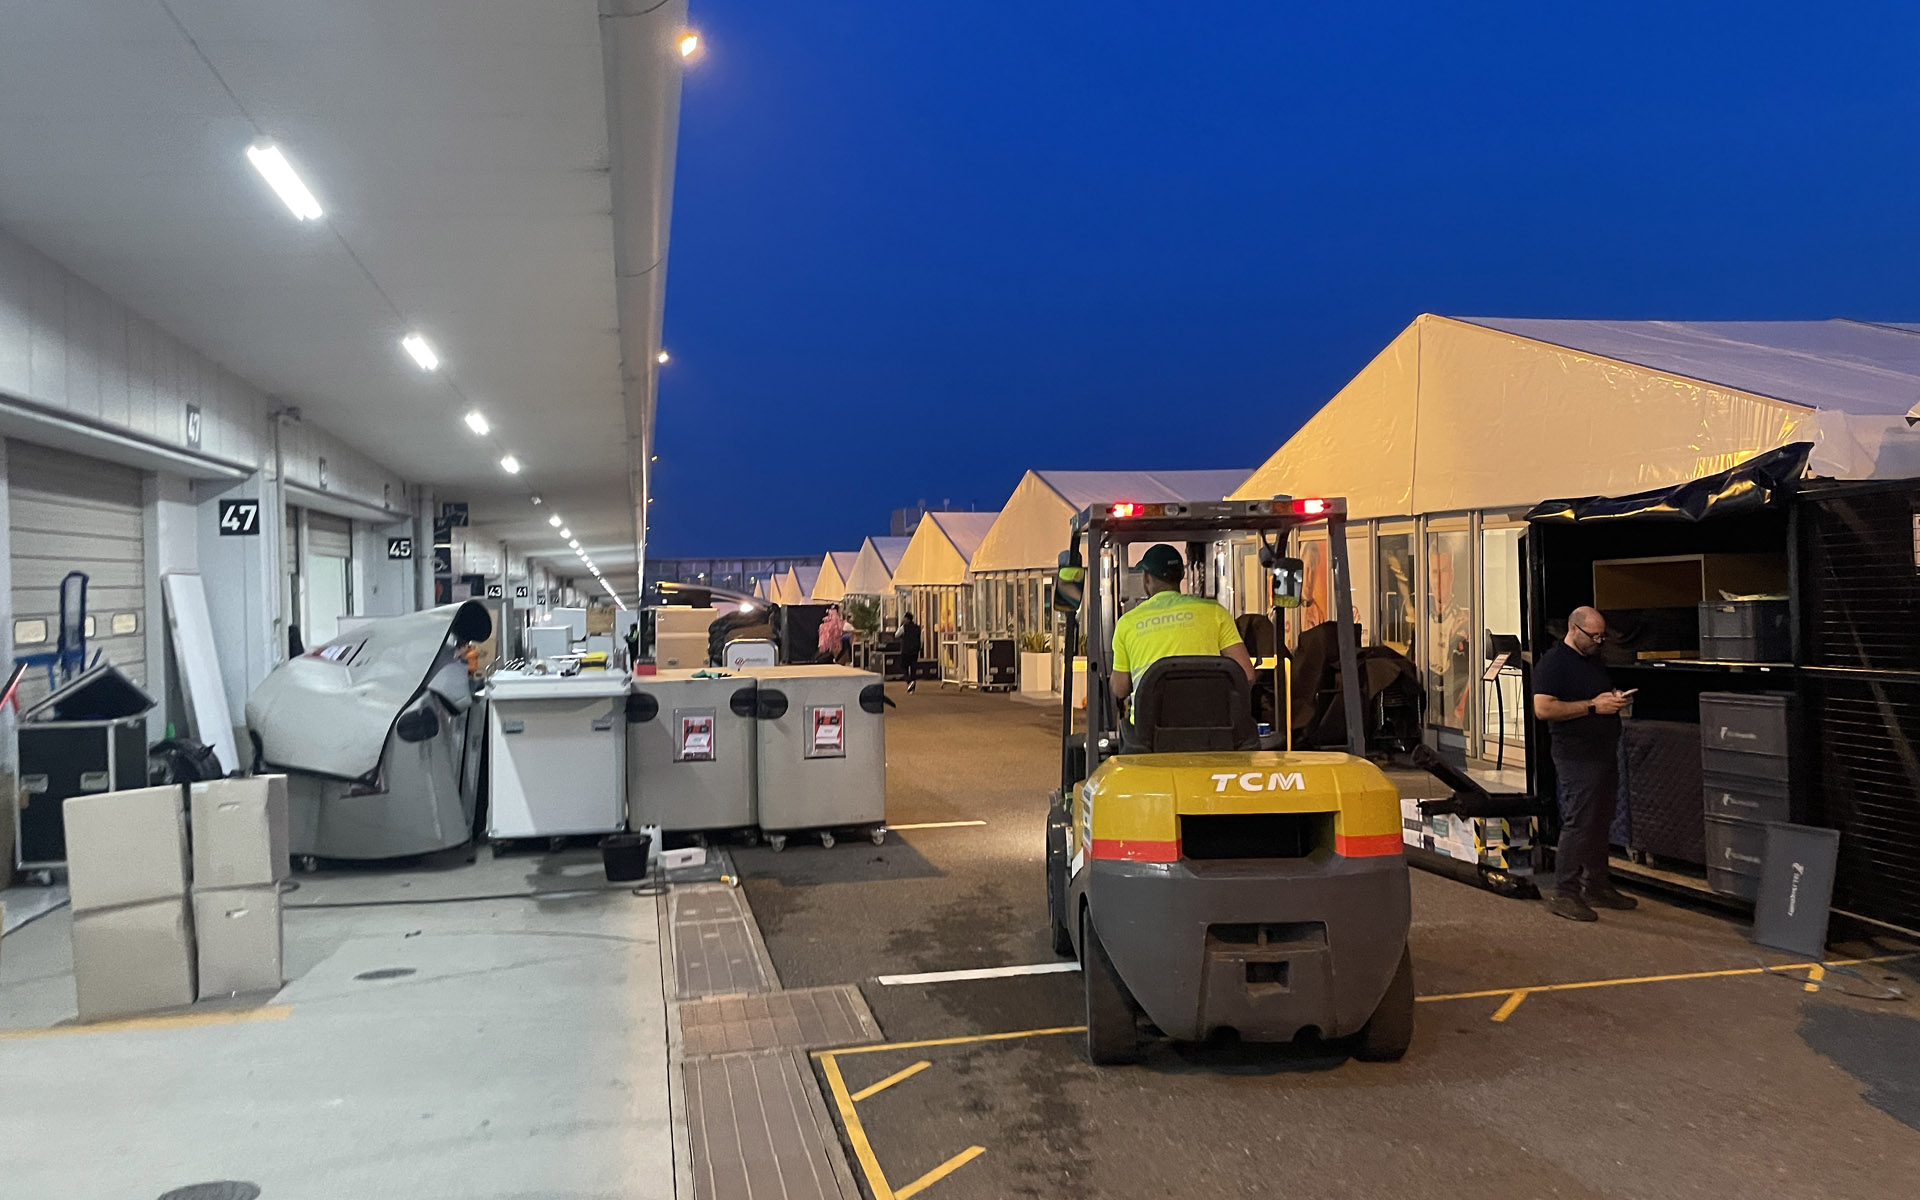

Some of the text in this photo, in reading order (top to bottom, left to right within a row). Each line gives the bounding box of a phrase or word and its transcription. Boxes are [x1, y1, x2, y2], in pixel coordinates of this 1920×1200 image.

[221, 504, 257, 531] 47
[389, 540, 411, 557] 45
[488, 586, 502, 597] 43
[517, 587, 527, 597] 41
[1136, 611, 1194, 630] aramco
[1211, 772, 1305, 792] TCM
